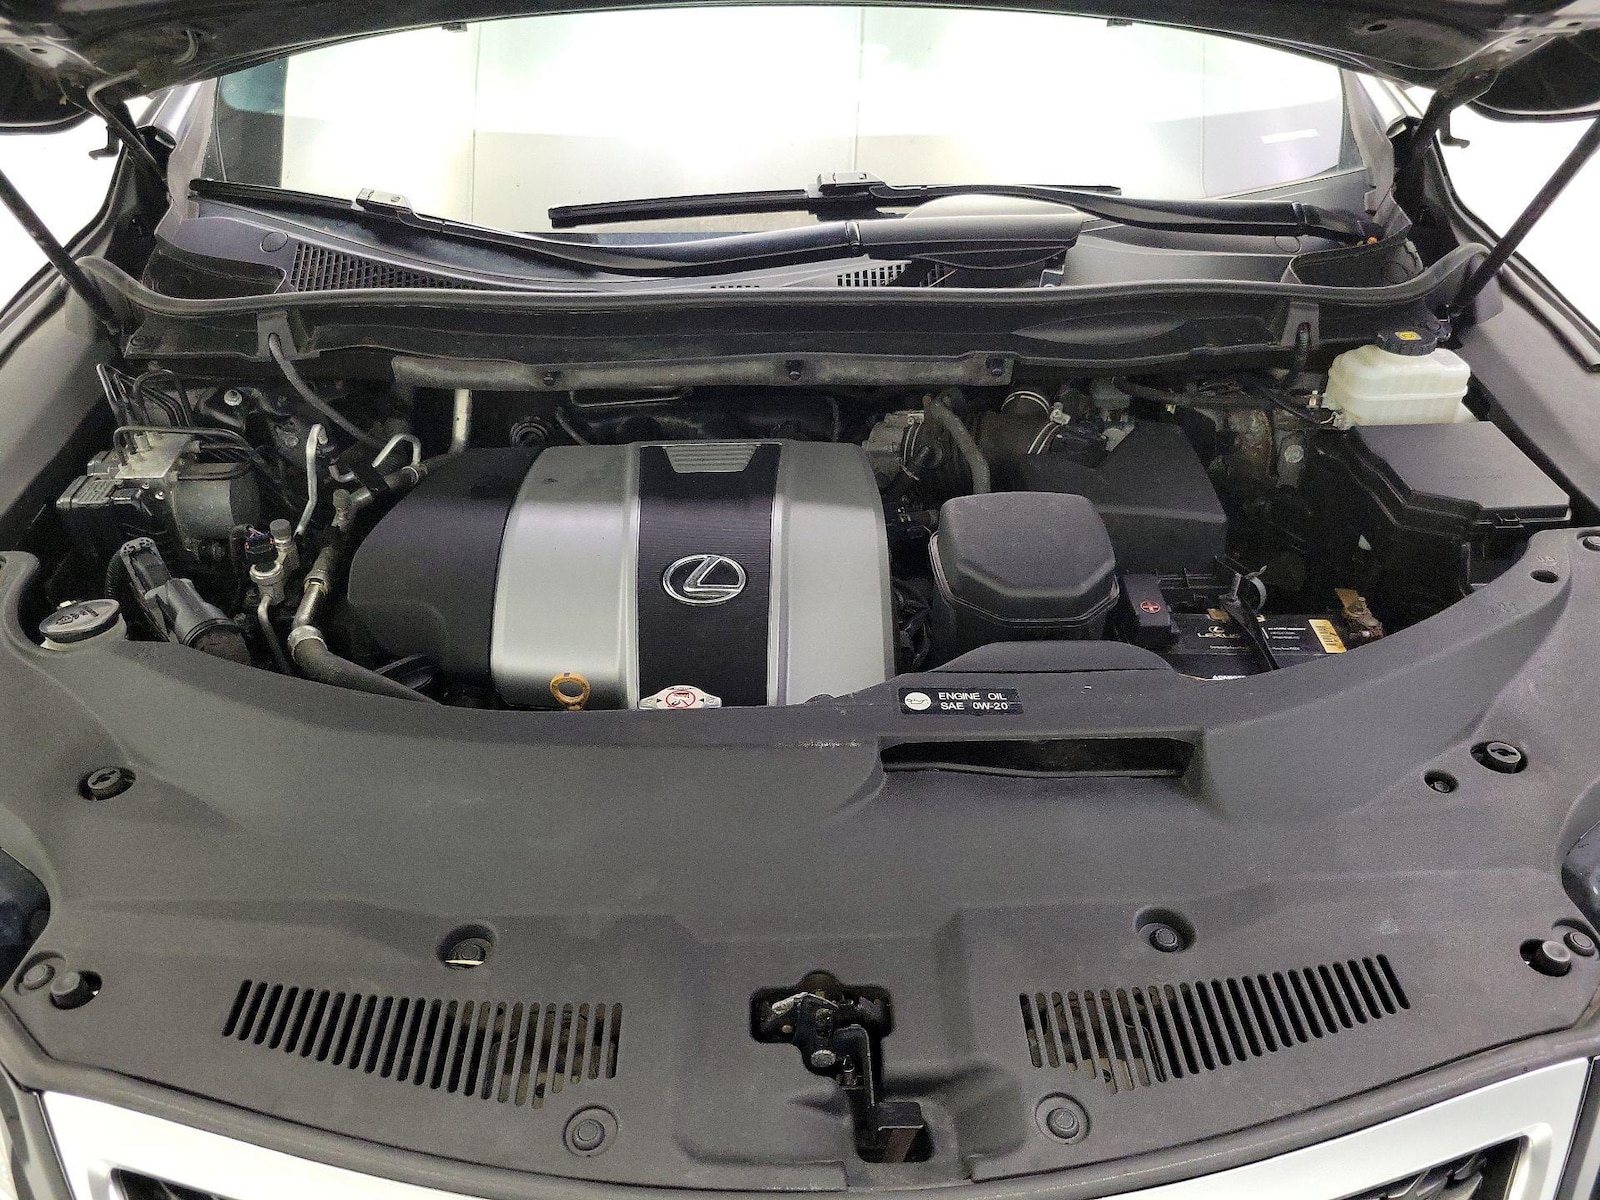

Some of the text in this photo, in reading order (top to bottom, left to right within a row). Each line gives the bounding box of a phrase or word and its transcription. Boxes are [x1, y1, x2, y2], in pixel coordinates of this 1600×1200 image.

[938, 692, 1008, 701] ENGINE OIL
[940, 702, 1009, 710] SAE 0W-20
